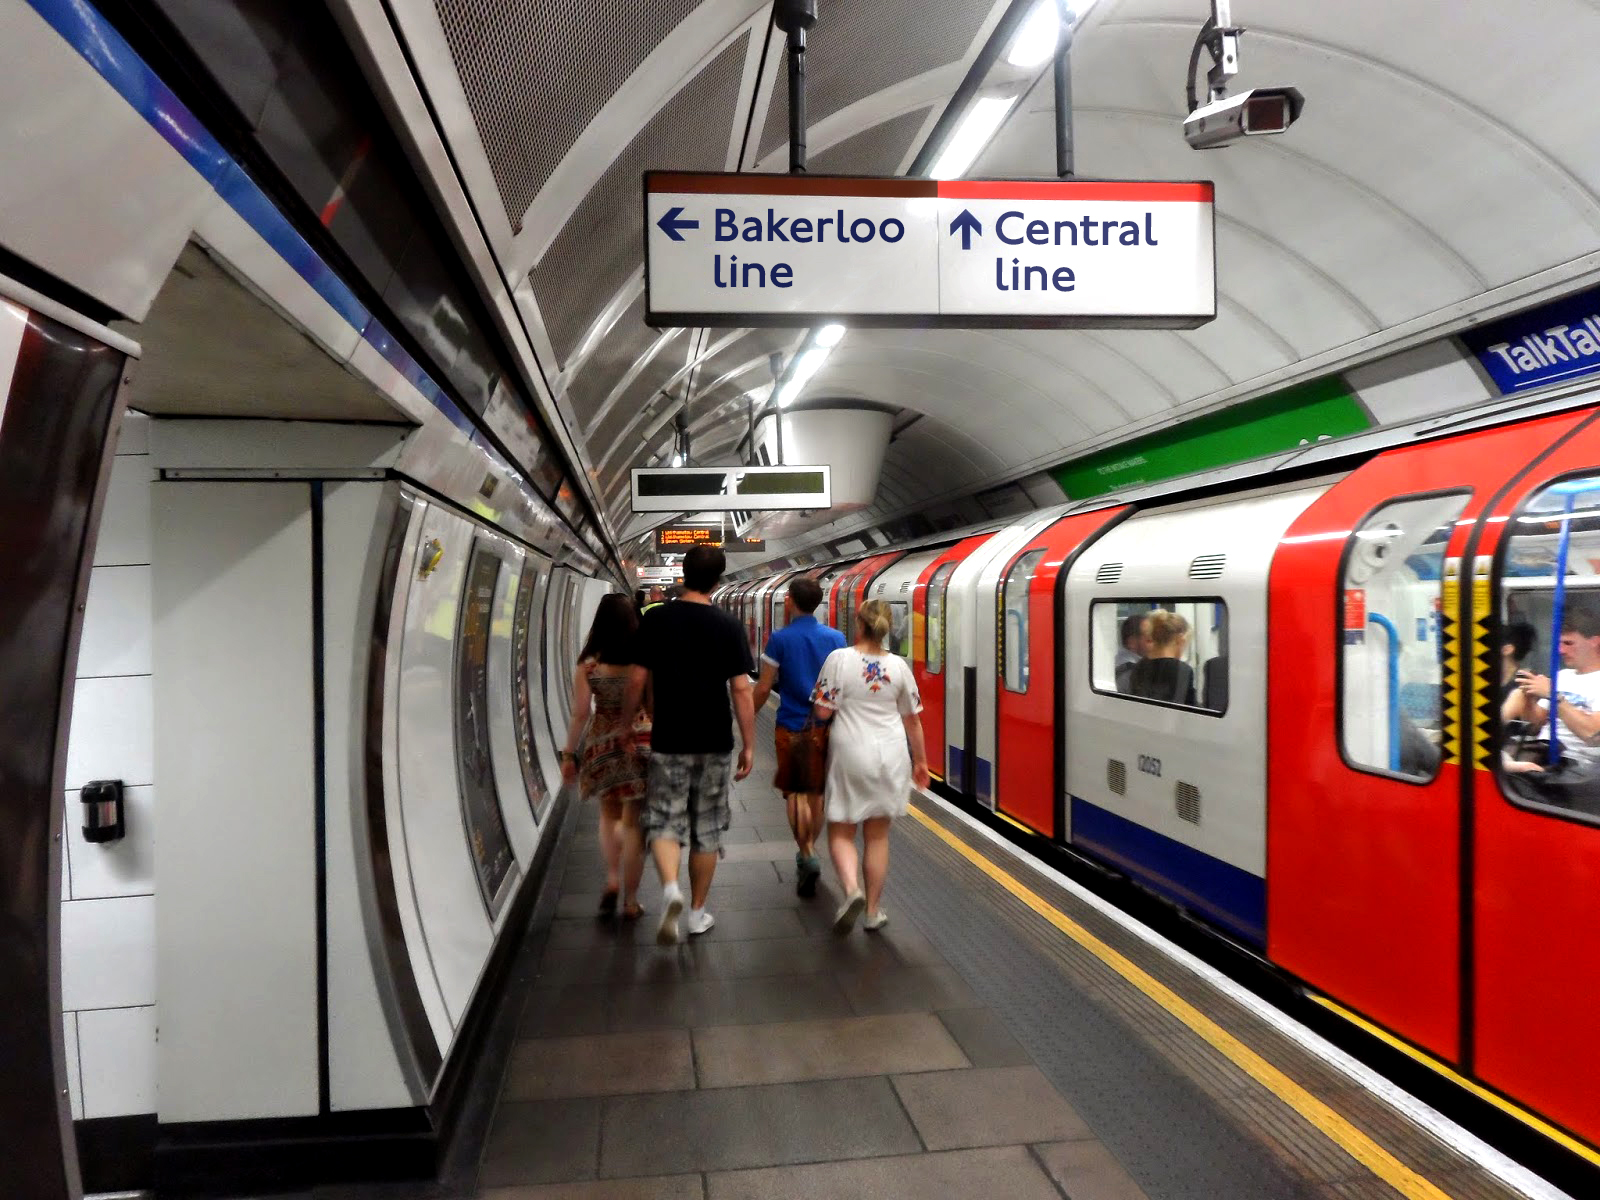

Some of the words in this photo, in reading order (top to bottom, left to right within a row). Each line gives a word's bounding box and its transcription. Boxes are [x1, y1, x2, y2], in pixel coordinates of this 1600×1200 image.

[715, 207, 906, 244] Bakerloo
[996, 211, 1158, 247] Central
[714, 255, 793, 289] line
[996, 257, 1076, 292] line
[1487, 314, 1600, 374] TalkTal
